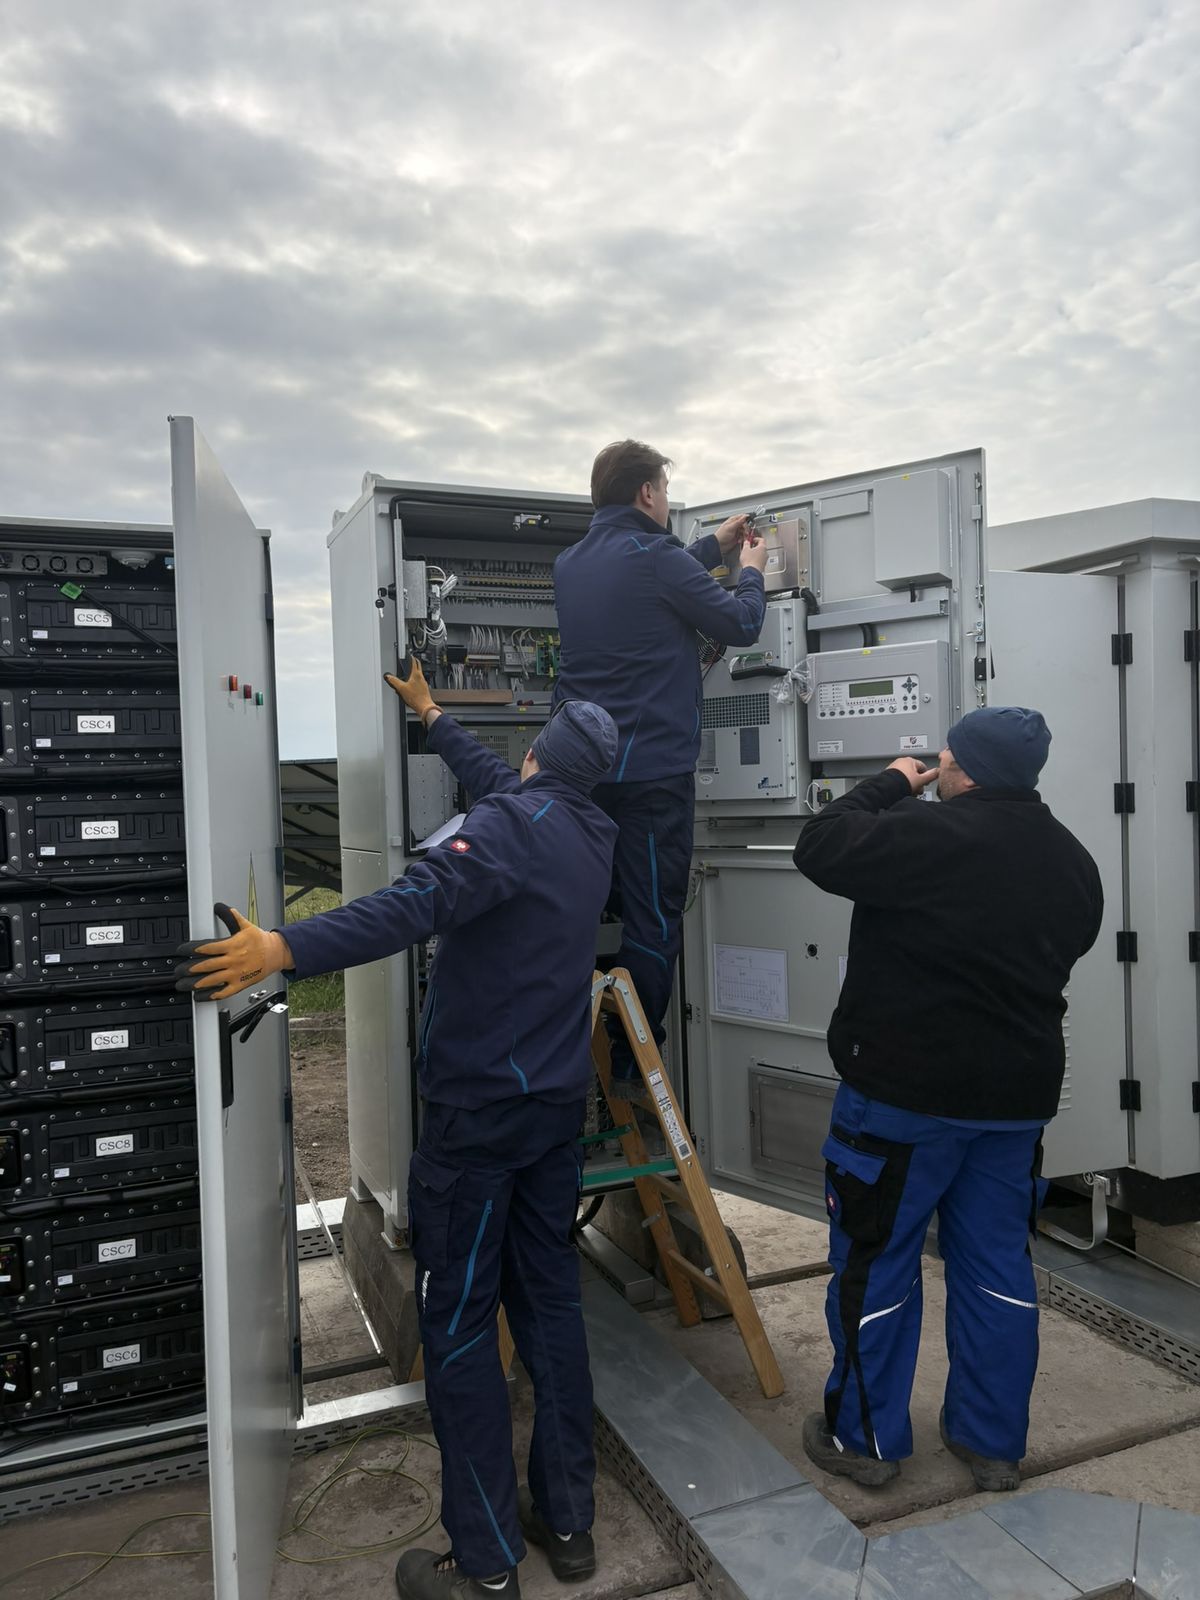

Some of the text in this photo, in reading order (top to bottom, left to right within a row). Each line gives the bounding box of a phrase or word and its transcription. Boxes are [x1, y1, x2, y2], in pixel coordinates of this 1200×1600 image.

[77, 613, 109, 624] CSC5
[80, 719, 112, 729] CSC4
[84, 825, 116, 835] CSC3
[89, 930, 121, 941] CSC2
[94, 1035, 125, 1046] CSC1
[99, 1138, 131, 1152] CSC8
[101, 1243, 133, 1257] CSC7
[106, 1349, 138, 1363] CSC6
